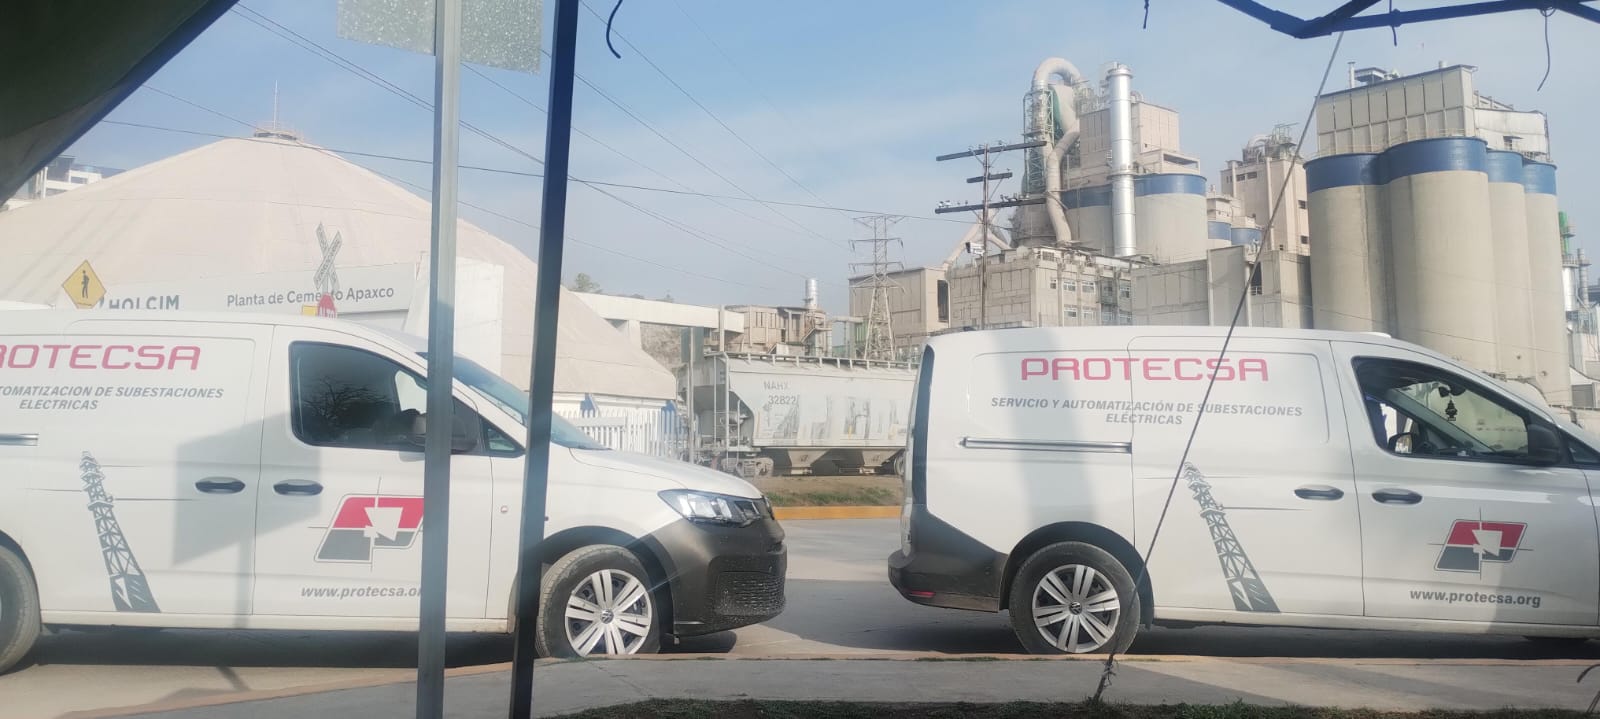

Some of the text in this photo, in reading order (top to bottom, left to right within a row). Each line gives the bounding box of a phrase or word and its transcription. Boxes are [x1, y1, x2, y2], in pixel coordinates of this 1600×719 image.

[227, 295, 265, 307] Planta
[268, 292, 284, 304] de
[346, 287, 394, 303] Apaxco
[1021, 358, 1269, 381] PROTECSA
[94, 387, 113, 397] DE
[115, 387, 224, 399] SUBESTACIONES
[991, 397, 1049, 409] SERVICIO
[1052, 400, 1060, 409] Y
[1062, 399, 1173, 412] AUTOMATIZACIÓN
[1176, 402, 1194, 413] DE
[301, 586, 421, 599] www.protecsa.o
[1410, 590, 1541, 608] www.protecsa.org
